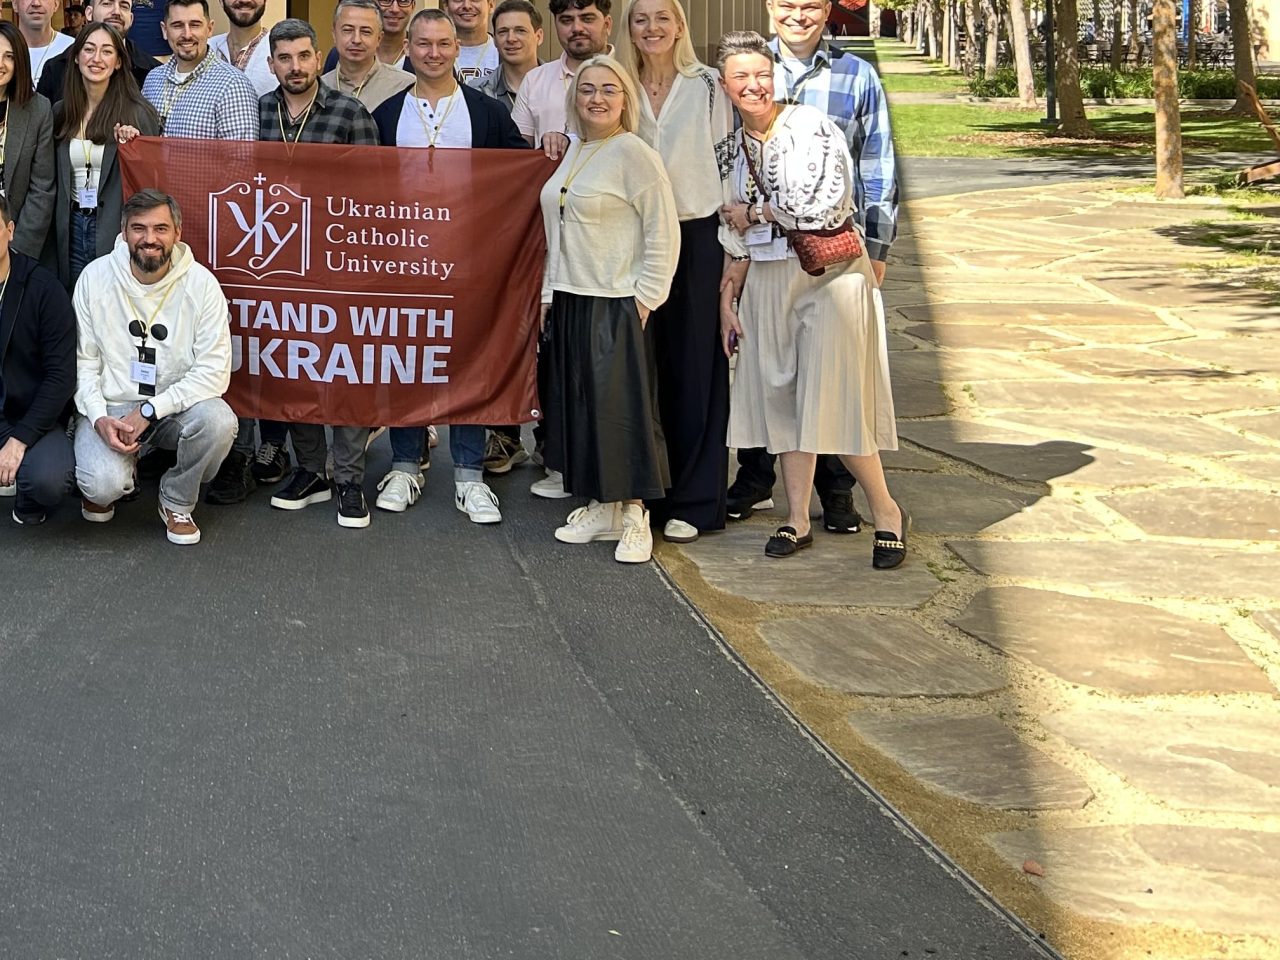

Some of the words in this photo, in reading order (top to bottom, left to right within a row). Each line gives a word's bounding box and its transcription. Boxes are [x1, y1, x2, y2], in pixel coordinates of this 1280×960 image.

[325, 196, 451, 221] Ukrainian
[325, 223, 430, 248] Catholic
[325, 251, 455, 281] University
[348, 306, 454, 338] WITH
